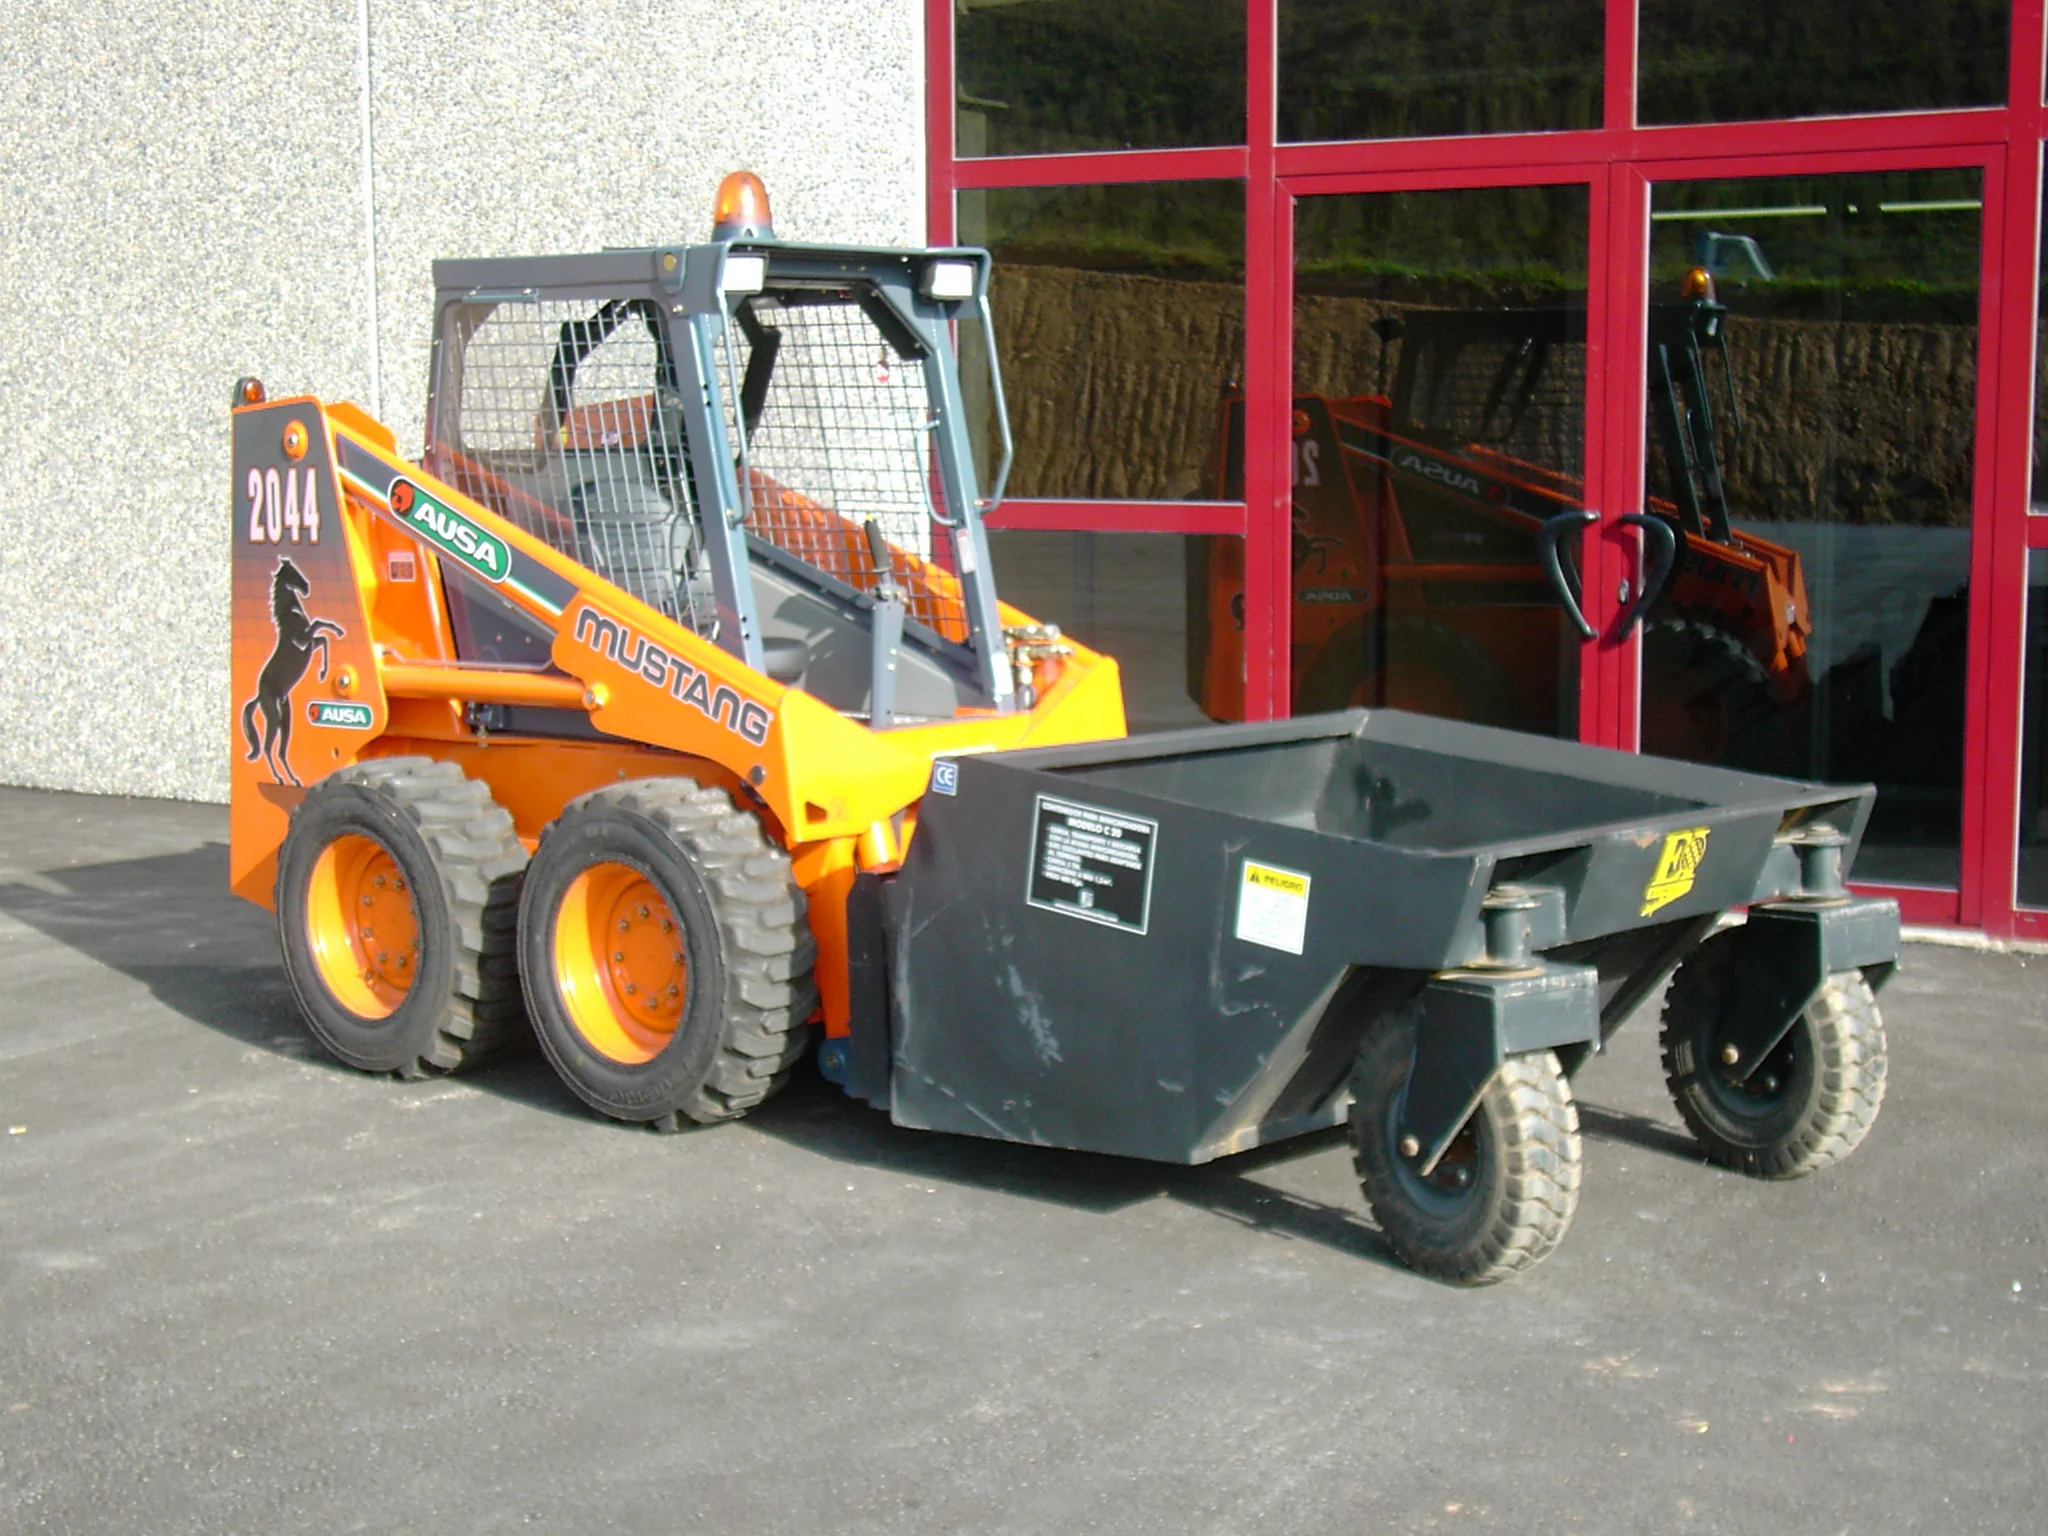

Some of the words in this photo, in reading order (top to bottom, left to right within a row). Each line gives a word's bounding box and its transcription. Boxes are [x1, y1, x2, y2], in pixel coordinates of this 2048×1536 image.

[248, 467, 320, 545] 2044
[414, 502, 499, 572] AUSA
[574, 605, 770, 746] MUSTANG
[321, 707, 368, 724] AUSA
[937, 766, 954, 786] CE
[1068, 817, 1102, 833] MODELO
[1264, 875, 1303, 892] PELIGRO
